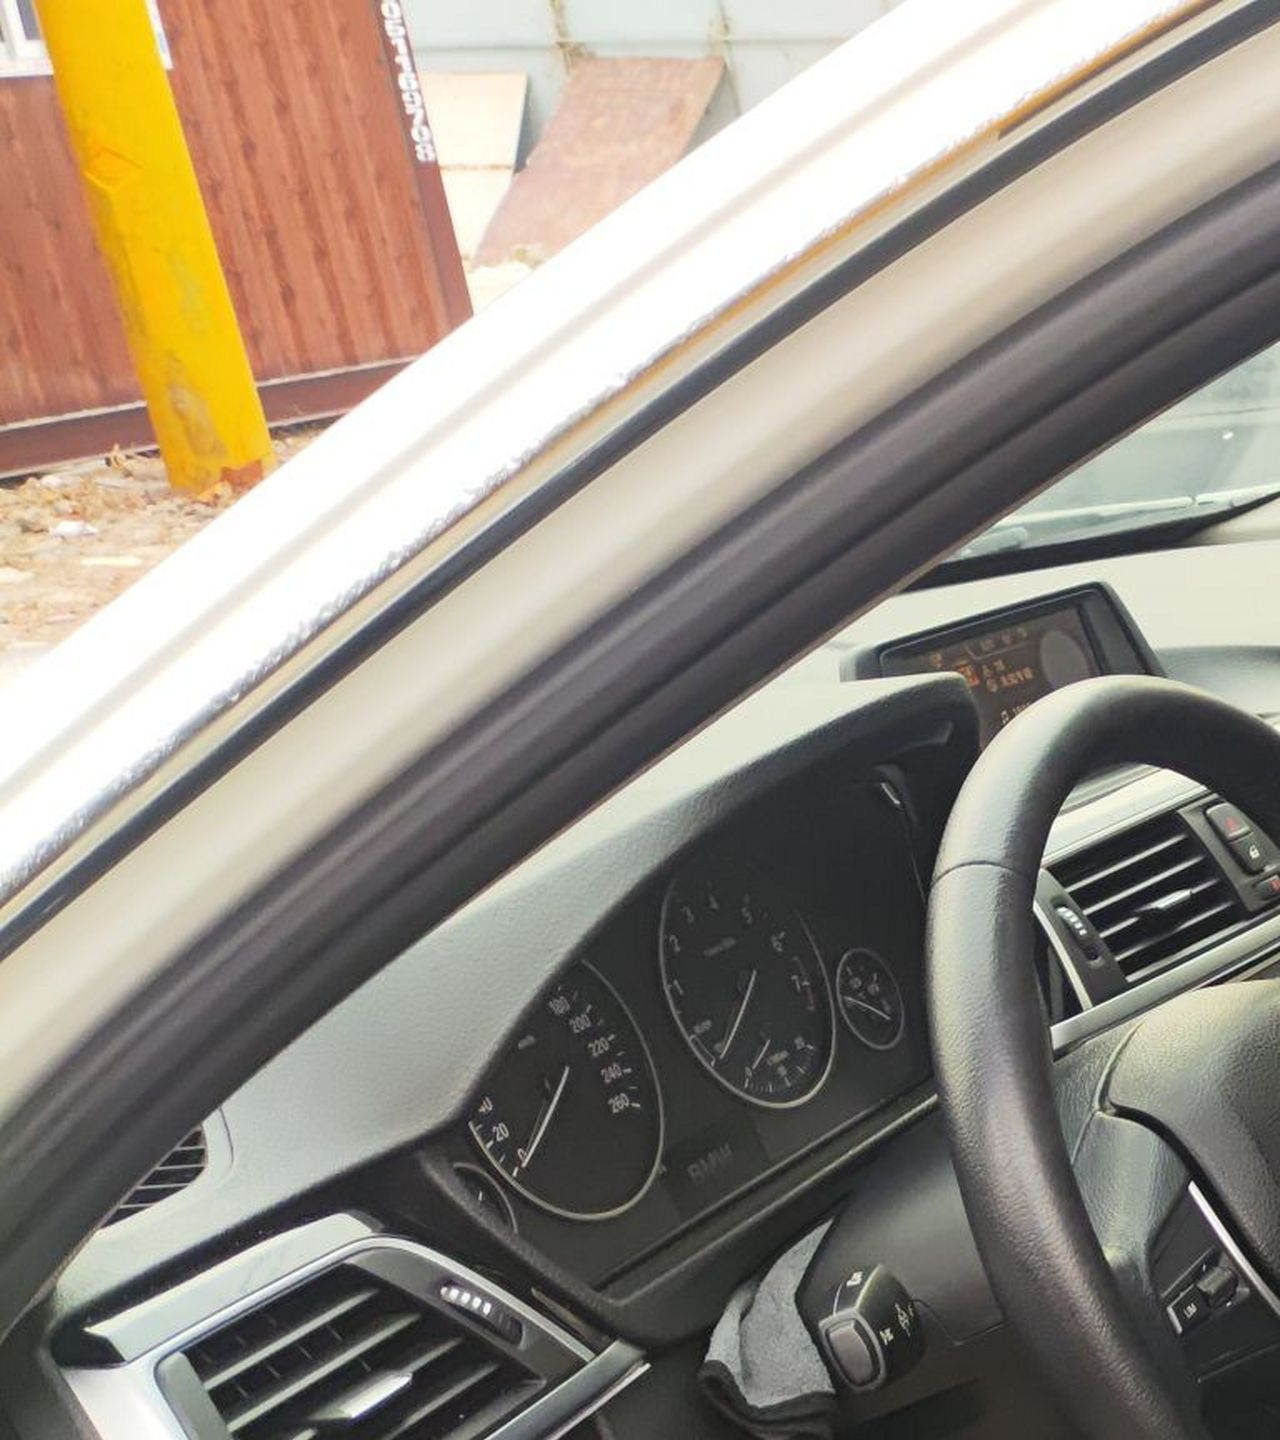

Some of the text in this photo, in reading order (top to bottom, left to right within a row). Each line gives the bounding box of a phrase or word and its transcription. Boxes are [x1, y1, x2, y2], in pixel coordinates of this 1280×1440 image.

[568, 1013, 592, 1034] 200
[587, 1037, 611, 1059] 220
[600, 1062, 623, 1085] 240
[608, 1092, 631, 1115] 260
[492, 1122, 510, 1143] 20
